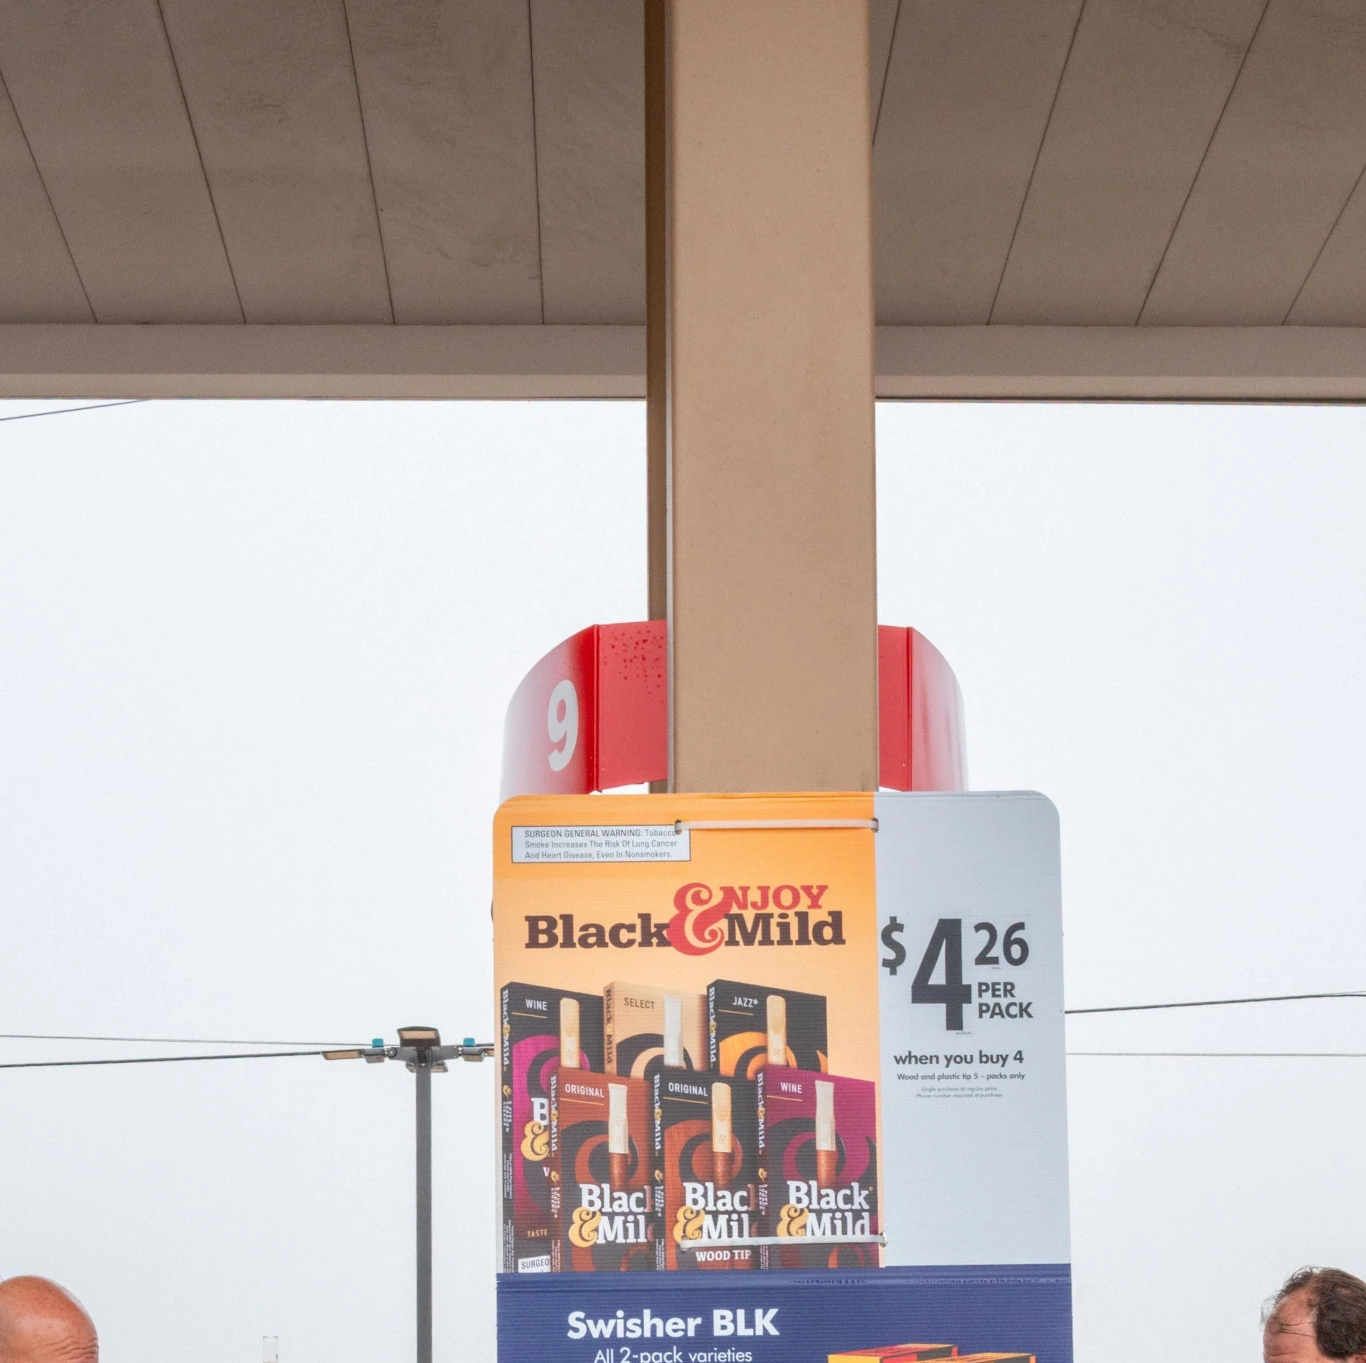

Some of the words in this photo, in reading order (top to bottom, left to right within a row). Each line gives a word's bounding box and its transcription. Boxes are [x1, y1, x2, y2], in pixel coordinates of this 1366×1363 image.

[548, 680, 579, 772] 9
[524, 829, 563, 838] SURGEON
[565, 829, 599, 838] GENERAL
[602, 829, 643, 838] WARNING:
[524, 841, 549, 849] Smoke
[551, 840, 587, 849] Increases
[590, 840, 603, 848] The
[605, 840, 620, 848] Risk
[622, 840, 630, 848] Of
[632, 840, 650, 849] Lung
[651, 839, 678, 848] Cancer
[525, 851, 540, 859] And
[542, 851, 561, 859] Heart
[563, 851, 595, 860] Disease,
[596, 851, 614, 859] Even
[616, 851, 623, 859] In
[625, 850, 673, 858] Nonsmokers.
[978, 982, 1016, 998] PER
[525, 998, 548, 1011] WINE
[623, 997, 655, 1010] SELECT
[978, 1002, 1034, 1019] PACK
[893, 1050, 940, 1065] when
[944, 1054, 974, 1068] you
[979, 1050, 1009, 1068] buy
[1013, 1050, 1025, 1064] 4
[897, 1073, 919, 1081] Wood
[937, 1073, 961, 1082] plastic
[962, 1073, 972, 1082] tip
[986, 1073, 1008, 1082] packs
[1009, 1072, 1026, 1081] only
[565, 1083, 605, 1098] ORIGINAL
[668, 1082, 709, 1097] ORIGINAL
[780, 1081, 803, 1094] WINE
[787, 1180, 869, 1210] Black
[527, 1228, 549, 1238] TASTE
[696, 1250, 731, 1262] WOOD
[733, 1249, 752, 1260] TIP
[567, 1309, 702, 1339] Swisher
[713, 1309, 780, 1336] BLK
[594, 1349, 614, 1363] All
[688, 1347, 752, 1363] varieties
